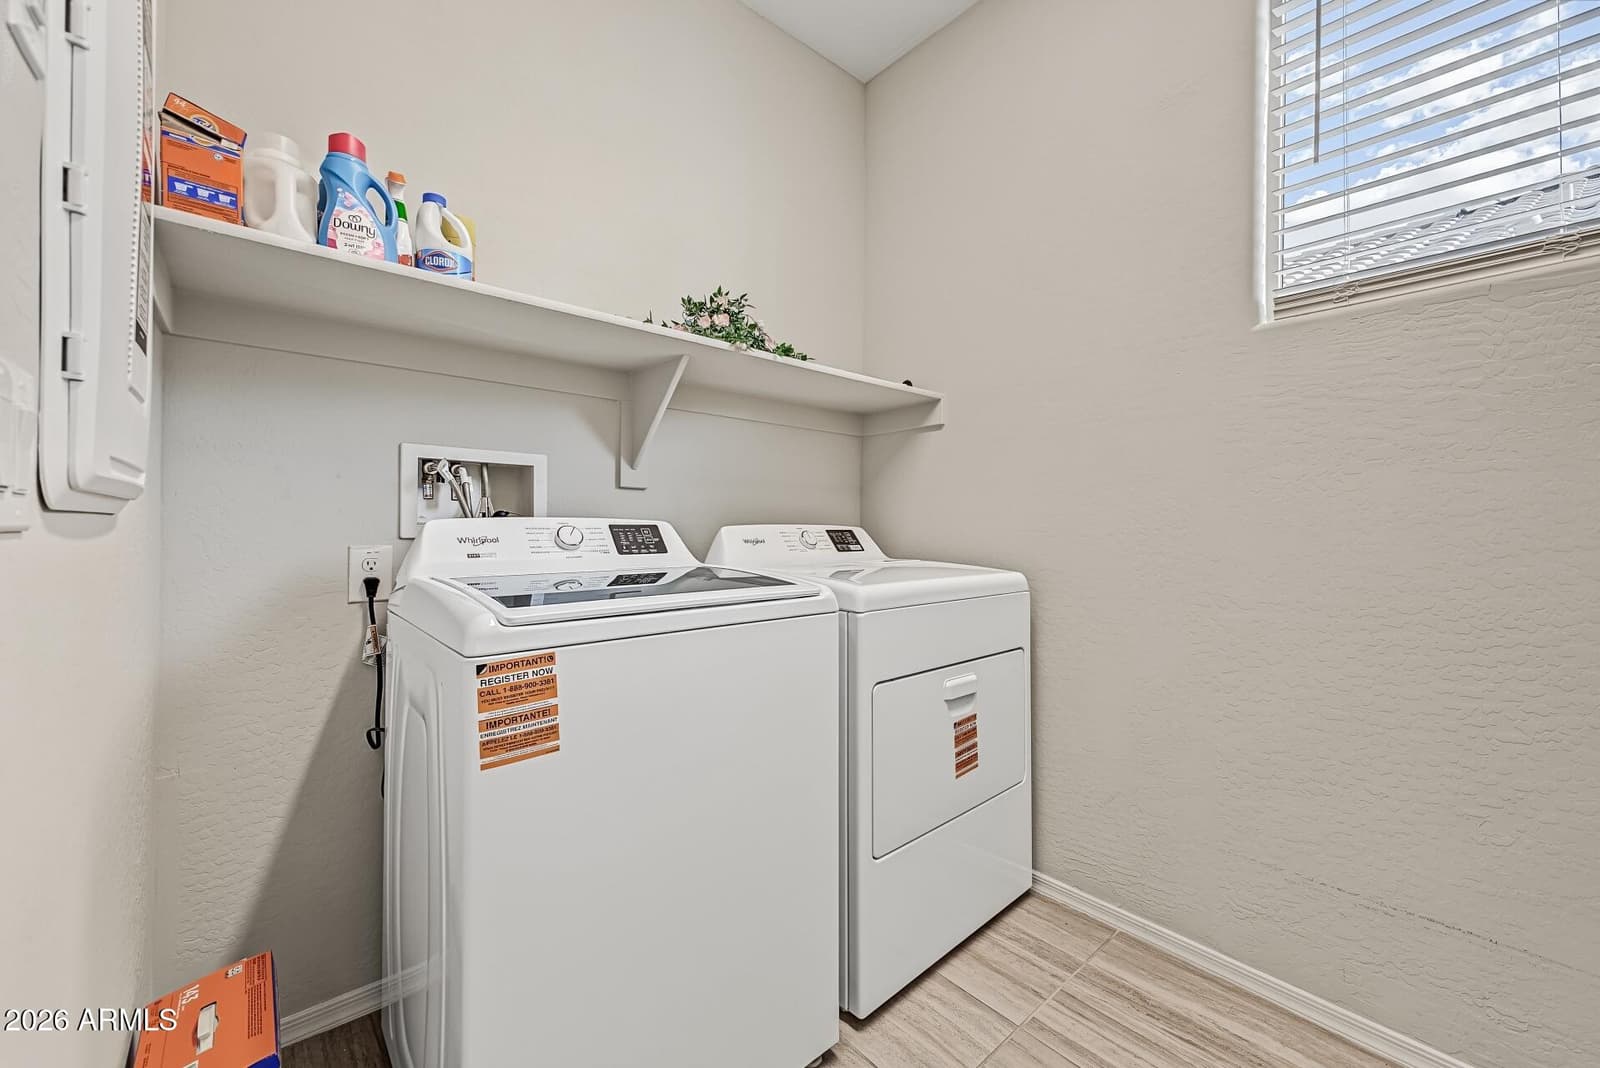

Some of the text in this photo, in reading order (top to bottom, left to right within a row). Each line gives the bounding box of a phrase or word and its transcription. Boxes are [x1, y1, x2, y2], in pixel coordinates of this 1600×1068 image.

[333, 216, 376, 239] Downy
[457, 535, 500, 547] Whirlpool
[488, 656, 547, 673] IMPORTANT!
[480, 667, 554, 687] REGISTER NOW
[479, 688, 501, 698] CALL
[486, 708, 551, 730] IMPORTANTE!
